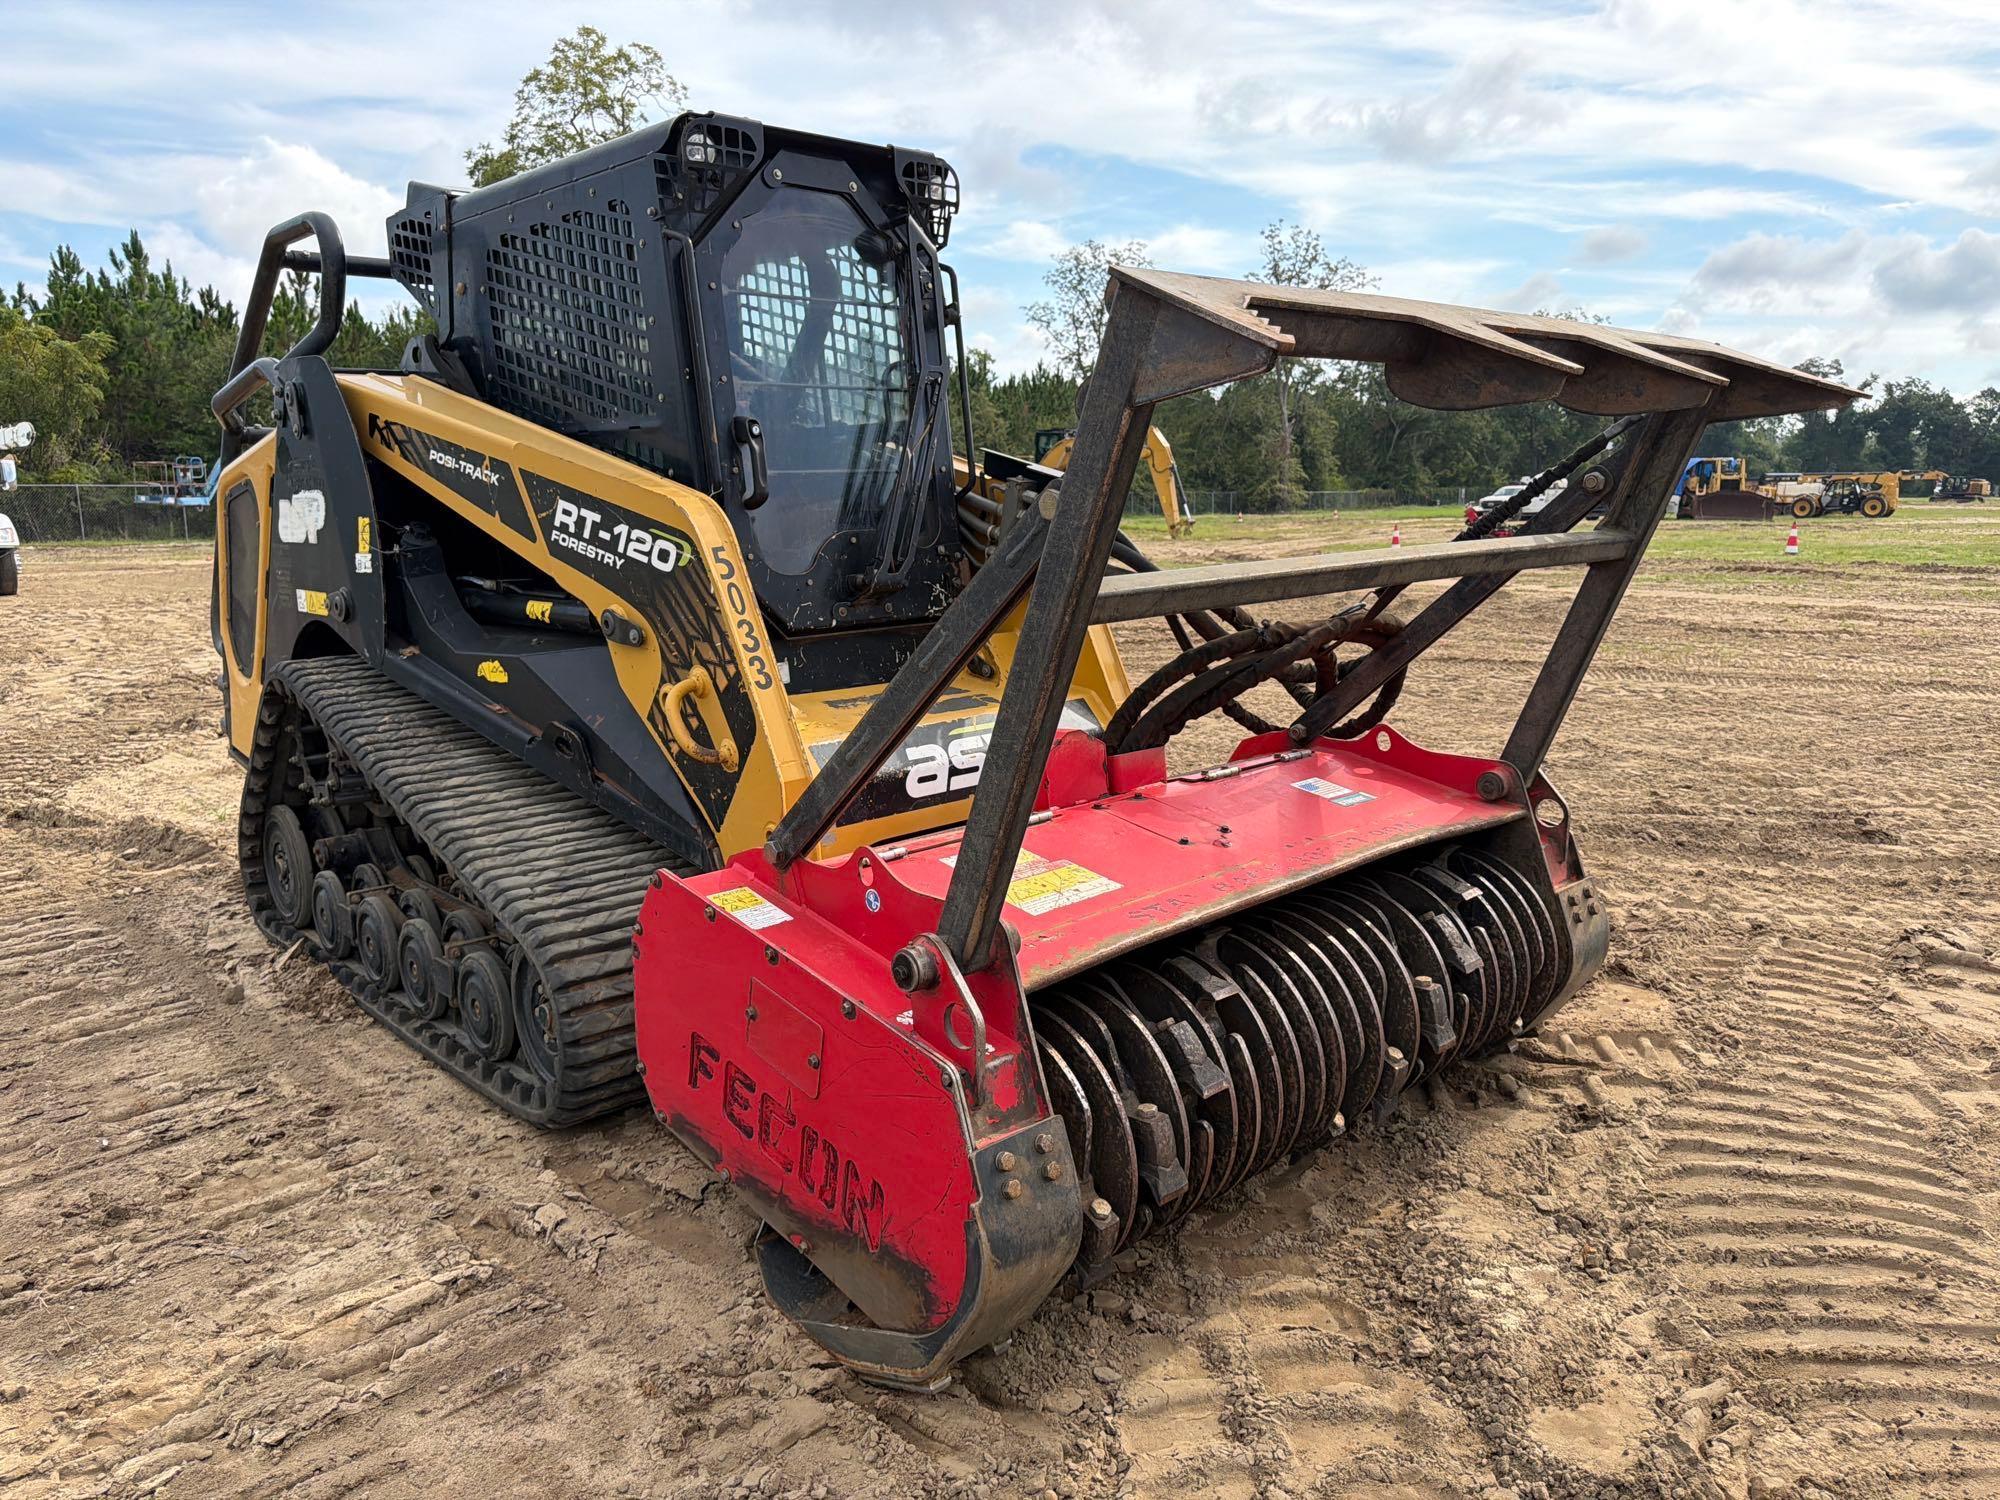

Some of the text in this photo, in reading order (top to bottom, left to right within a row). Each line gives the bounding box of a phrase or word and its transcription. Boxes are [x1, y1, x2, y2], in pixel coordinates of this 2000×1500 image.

[429, 449, 501, 486] POSI-TRACK
[551, 530, 625, 570] FORESTRY
[554, 499, 677, 573] RT-120
[711, 546, 773, 690] 5033
[905, 733, 992, 798] as
[688, 1031, 885, 1253] FECON
